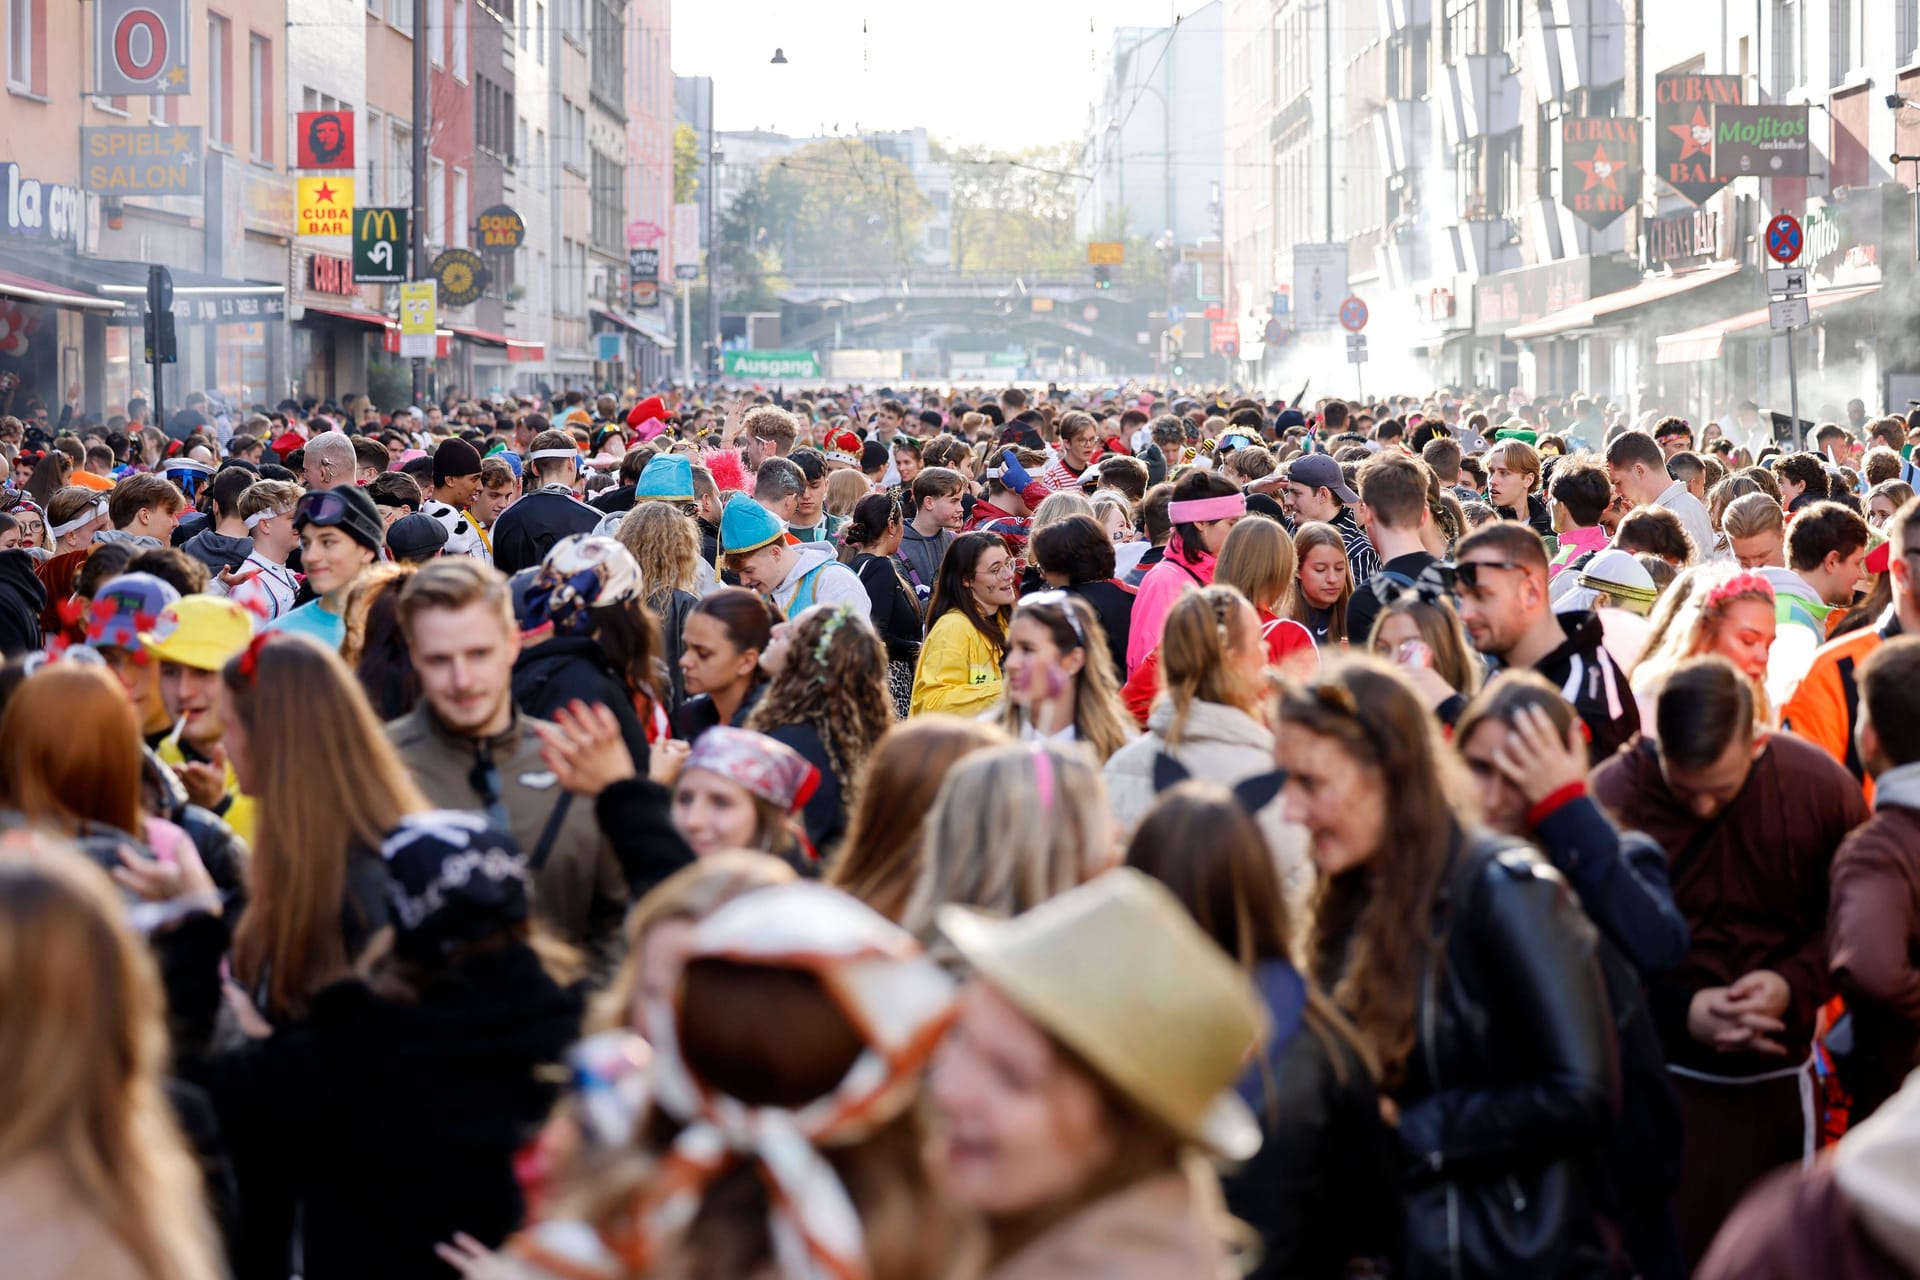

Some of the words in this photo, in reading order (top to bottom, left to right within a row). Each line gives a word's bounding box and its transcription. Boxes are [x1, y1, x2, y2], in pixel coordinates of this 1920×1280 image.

[1656, 77, 1741, 106] CUBANA
[1563, 119, 1637, 145] CUBANA
[1717, 115, 1806, 146] Mojitos
[90, 133, 169, 157] SPIEL
[90, 165, 187, 189] SALON
[1670, 162, 1729, 183] BA
[8, 163, 42, 228] la
[1574, 194, 1626, 212] BAR
[303, 208, 349, 220] CUBA
[479, 215, 522, 231] SOUL
[309, 223, 343, 233] BAR
[484, 232, 517, 246] BAR
[314, 254, 338, 295] CUBA
[734, 356, 814, 377] Ausgang
